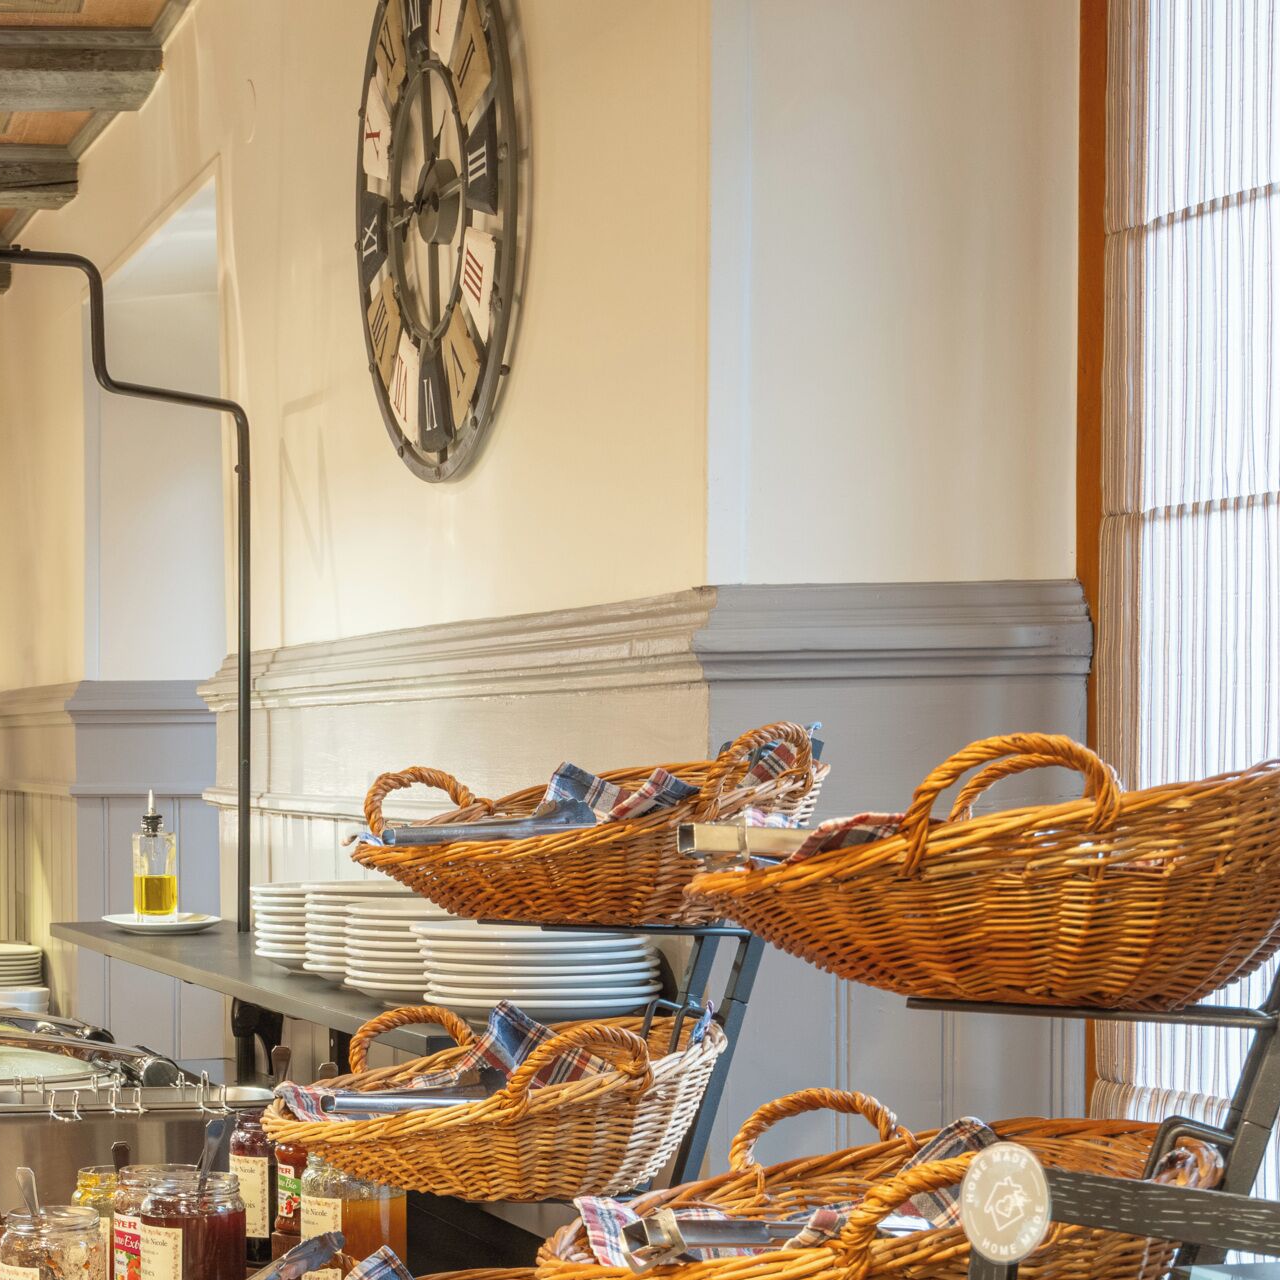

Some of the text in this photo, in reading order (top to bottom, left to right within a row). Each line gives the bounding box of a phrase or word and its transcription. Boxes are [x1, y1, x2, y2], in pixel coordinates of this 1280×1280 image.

[467, 140, 487, 188] III
[966, 1151, 1027, 1203] HOME MADE
[982, 1205, 1045, 1256] HOME MADE
